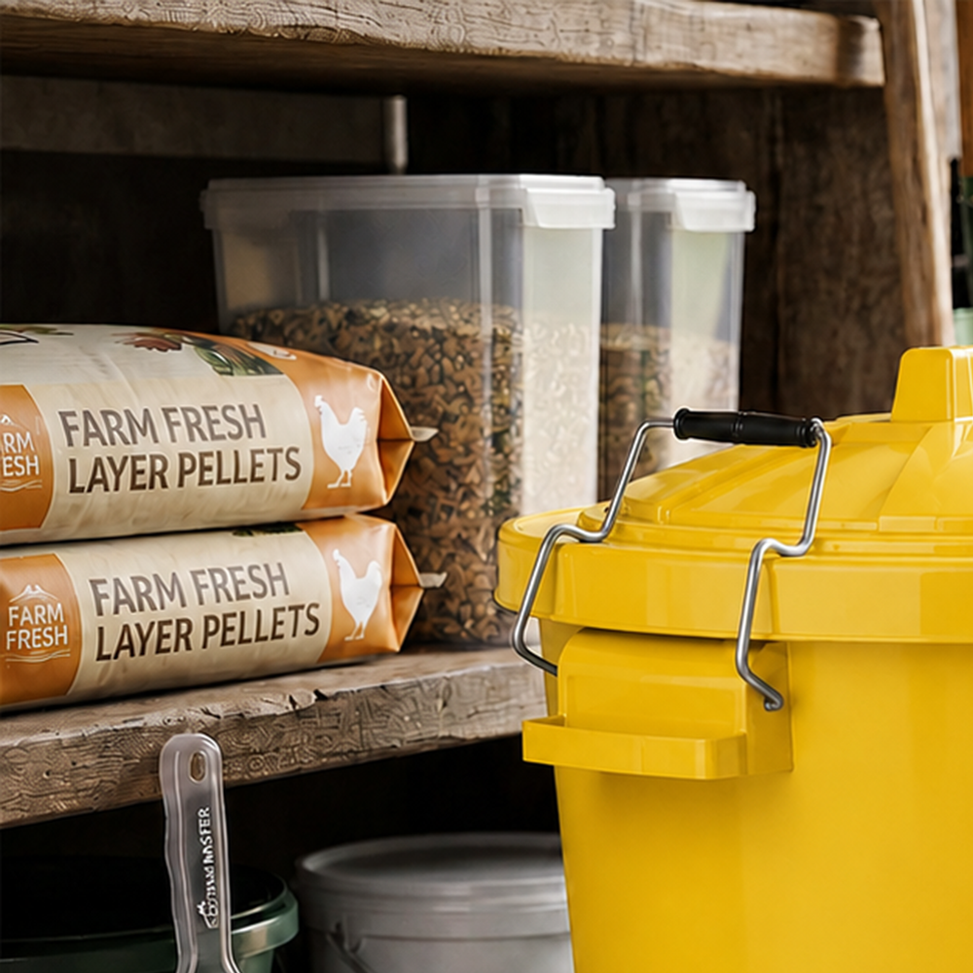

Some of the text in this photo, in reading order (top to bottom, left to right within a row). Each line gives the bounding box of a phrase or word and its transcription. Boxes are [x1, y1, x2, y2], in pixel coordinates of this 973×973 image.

[2, 431, 35, 454] RM
[58, 404, 267, 447] FARM FRESH
[2, 455, 40, 477] ESH
[69, 447, 302, 494] LAYER PELLETS
[89, 562, 290, 616] FARM FRESH
[8, 603, 64, 627] FARM
[96, 603, 320, 661] LAYER PELLETS
[6, 625, 68, 650] FRESH
